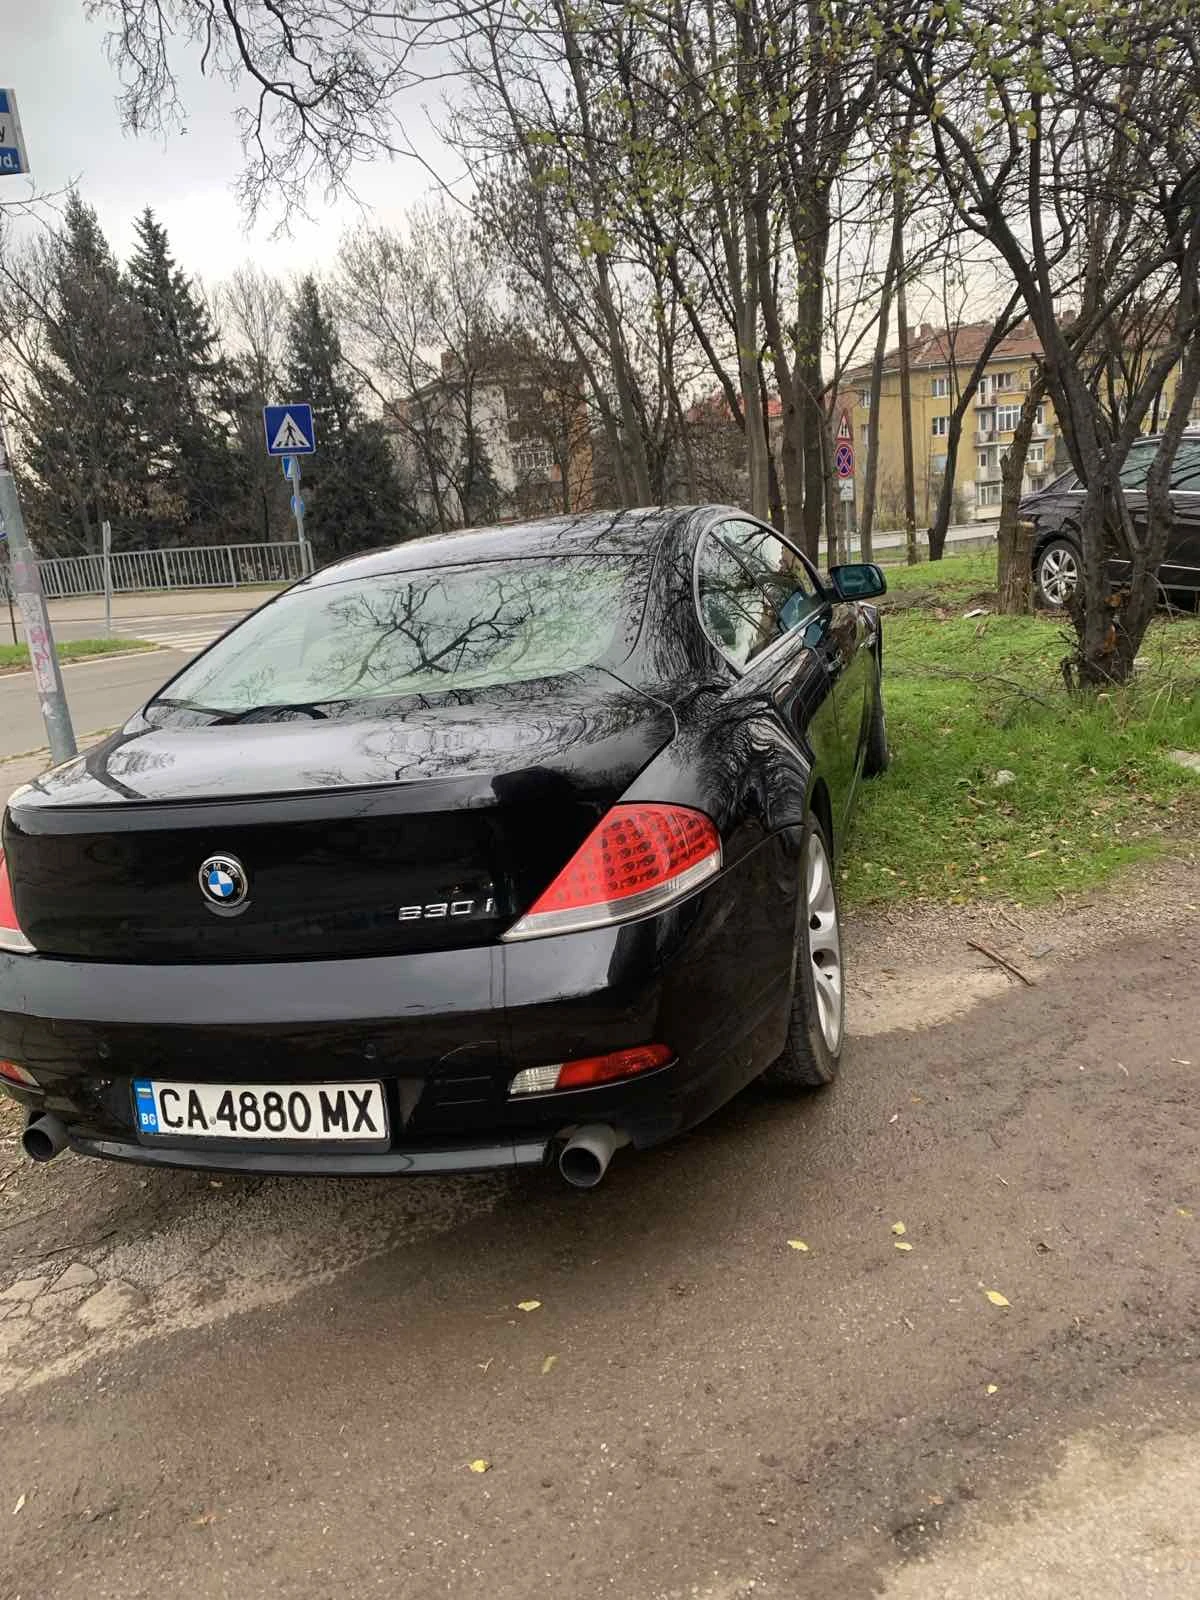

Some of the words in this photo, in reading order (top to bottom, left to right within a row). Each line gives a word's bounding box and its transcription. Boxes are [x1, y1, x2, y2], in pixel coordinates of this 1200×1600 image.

[203, 863, 240, 878] BMW
[159, 1088, 208, 1129] CA
[216, 1090, 312, 1133] 4880
[318, 1090, 377, 1133] MX
[141, 1112, 156, 1126] BG
